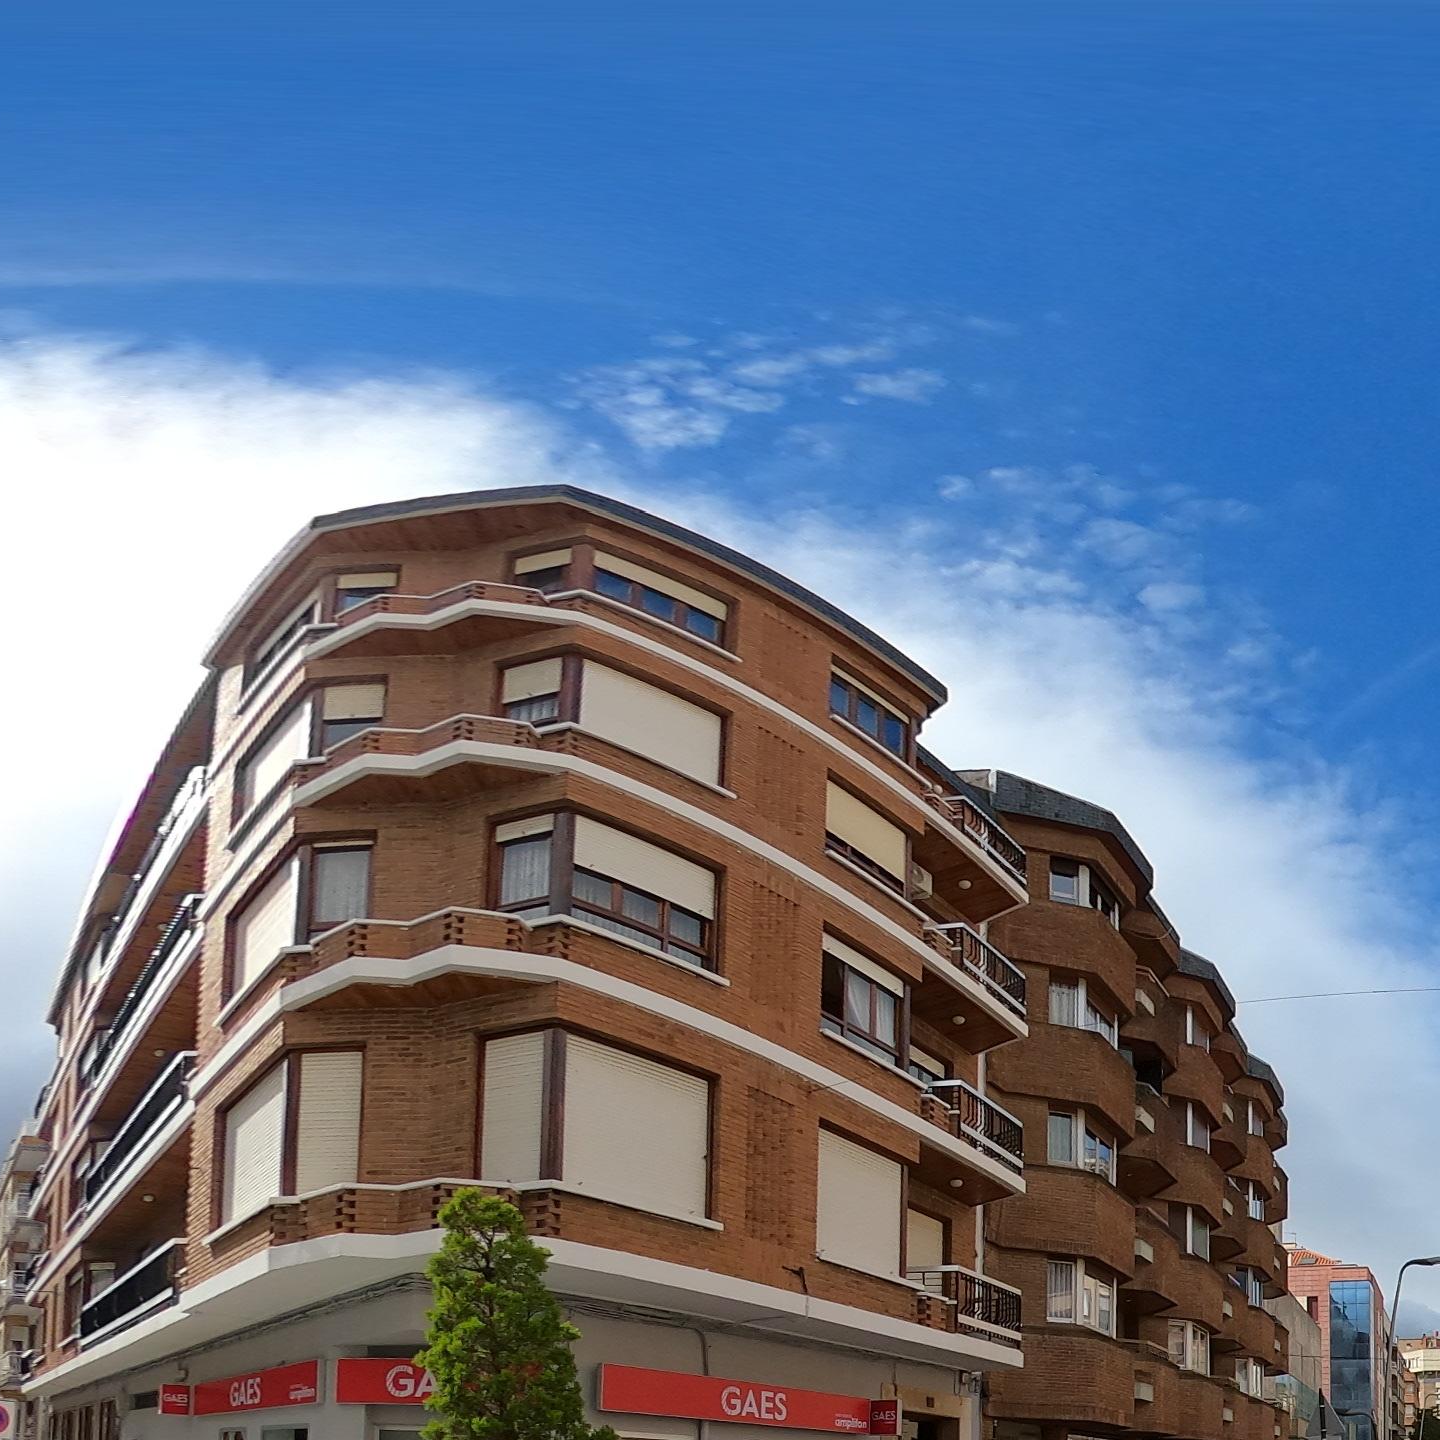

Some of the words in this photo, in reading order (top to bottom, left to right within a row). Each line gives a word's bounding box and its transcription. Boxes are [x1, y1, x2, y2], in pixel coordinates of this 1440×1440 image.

[230, 1377, 261, 1407] GAES
[386, 1365, 440, 1398] GA
[164, 1393, 188, 1403] GAES
[721, 1386, 788, 1421] GAES
[872, 1410, 897, 1421] GAES
